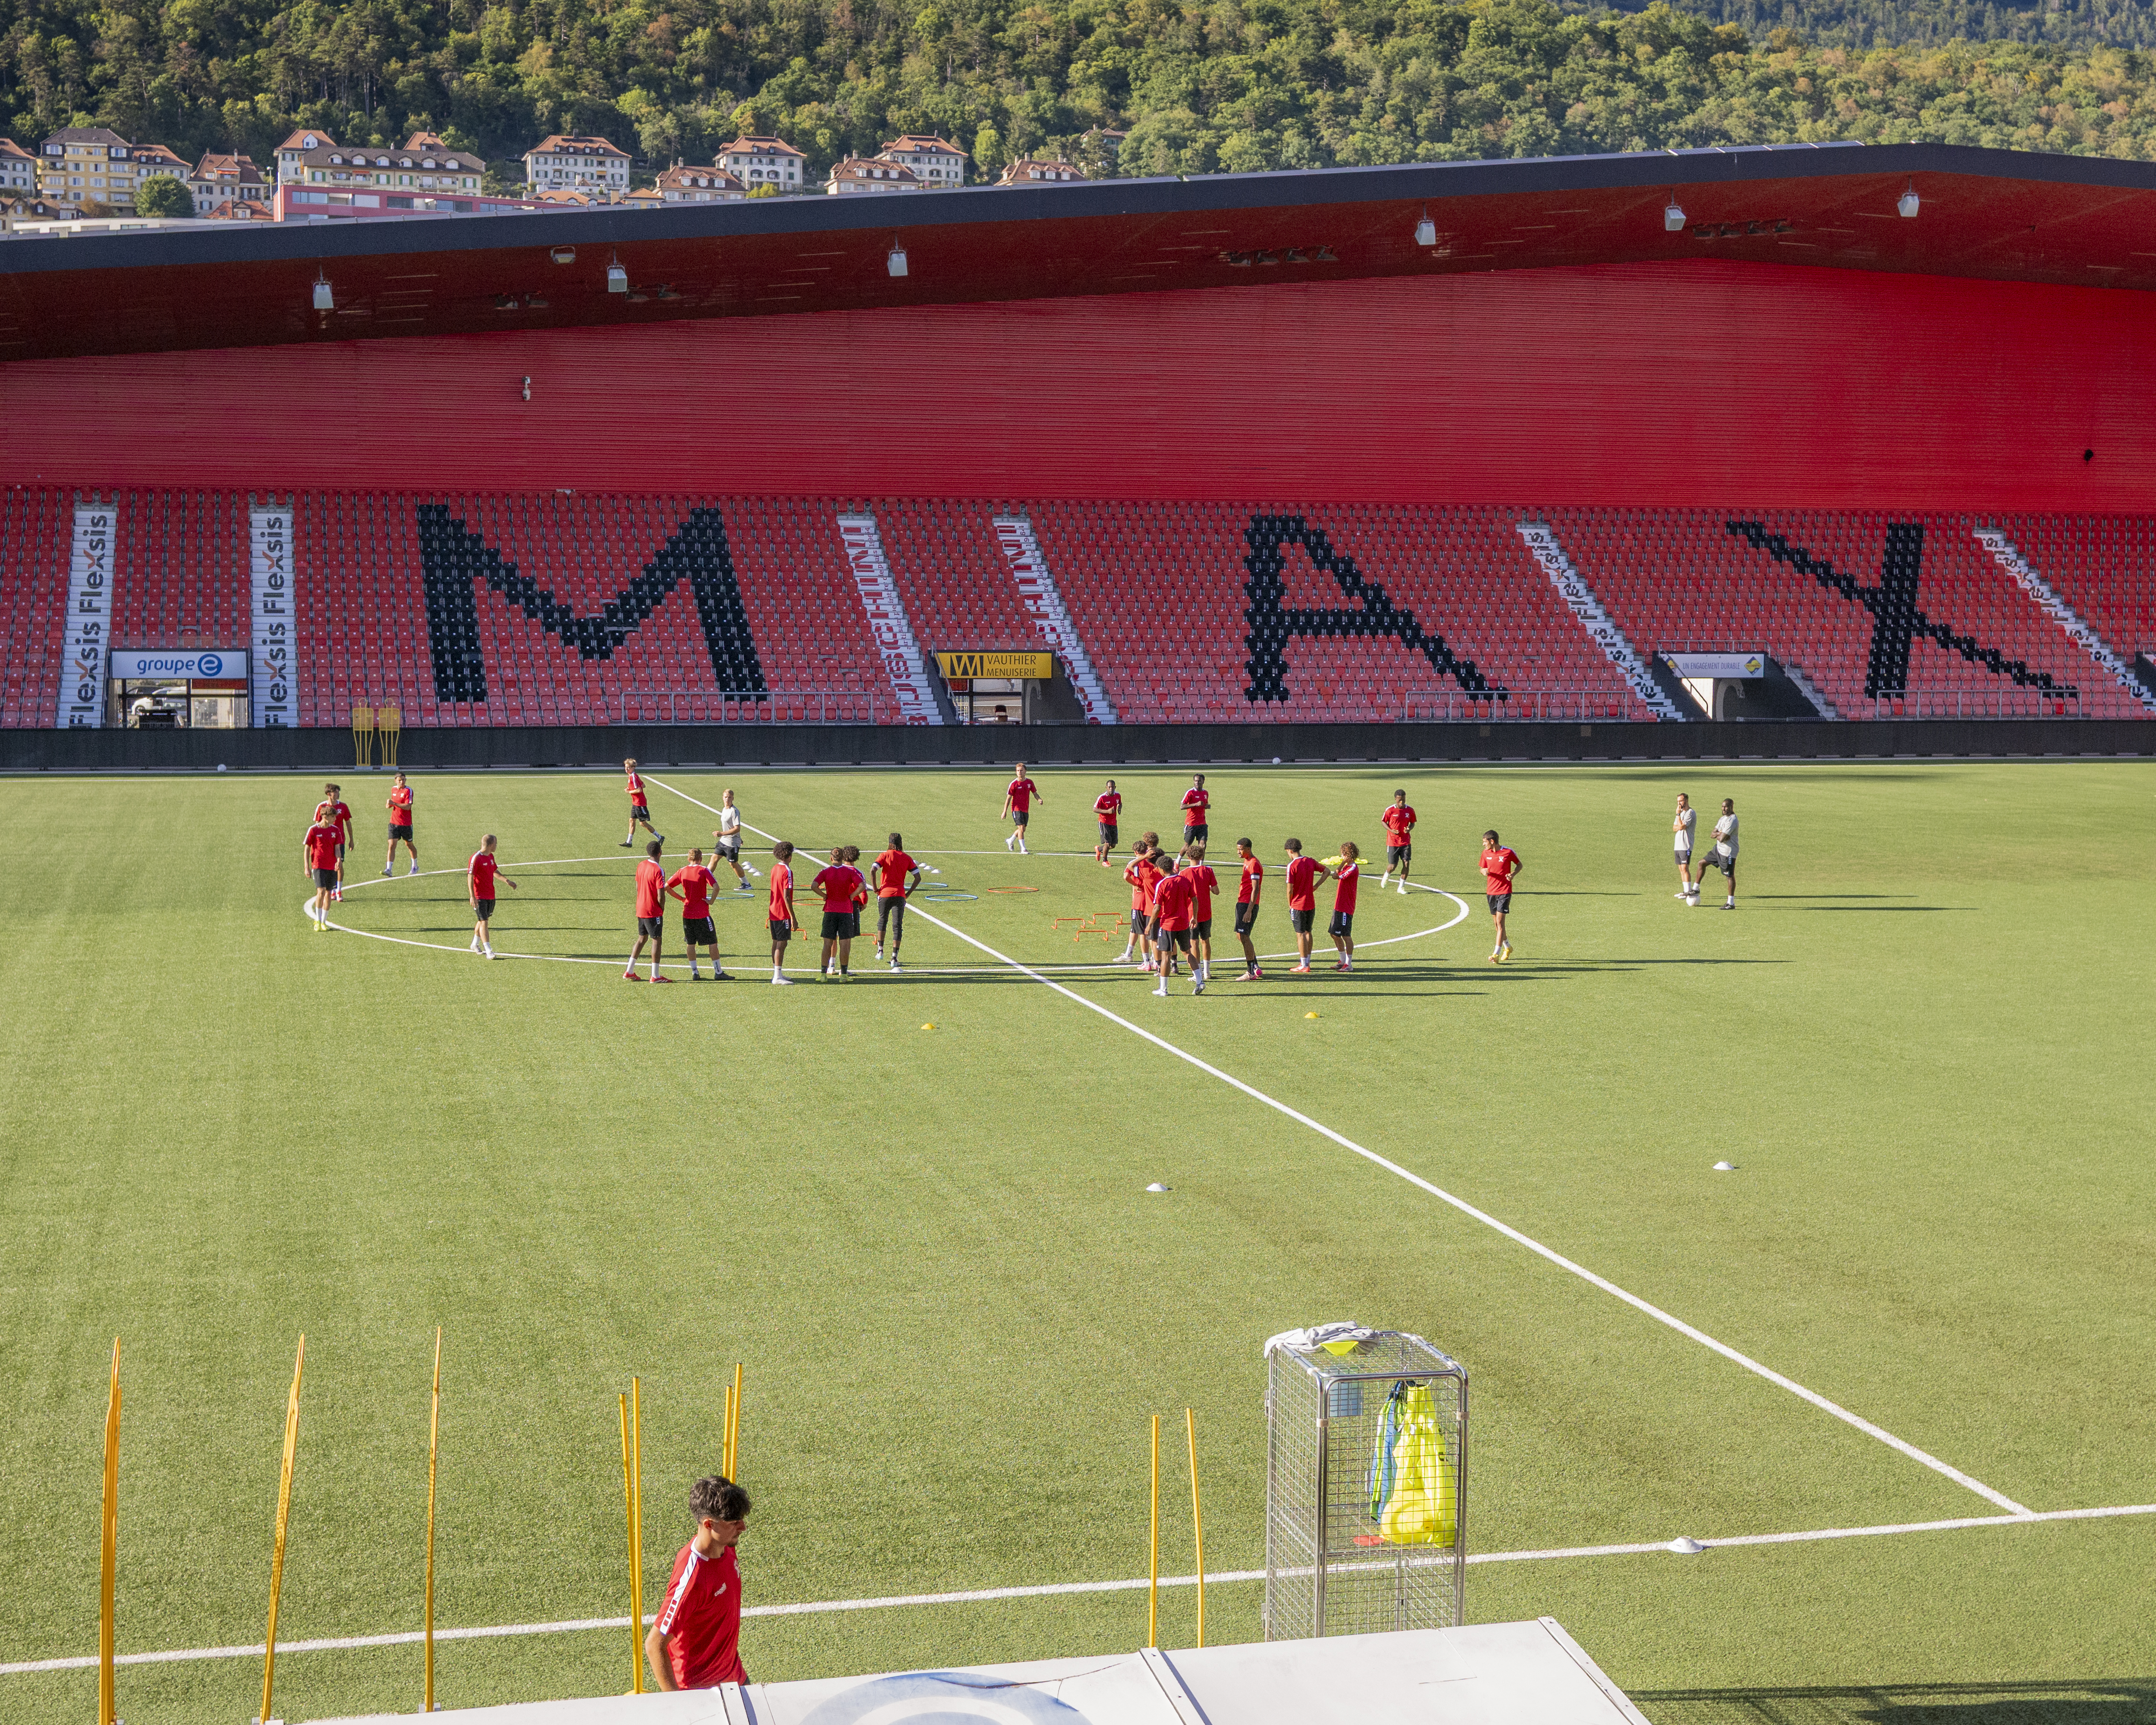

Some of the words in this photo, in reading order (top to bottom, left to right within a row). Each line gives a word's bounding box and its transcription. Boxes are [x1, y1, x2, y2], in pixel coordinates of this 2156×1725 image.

[79, 515, 107, 613] Flexsis
[260, 517, 285, 614] Flexsis
[137, 659, 195, 675] groupe
[986, 655, 1037, 665] VAUTHIER
[986, 668, 1037, 676] MENUISERIE
